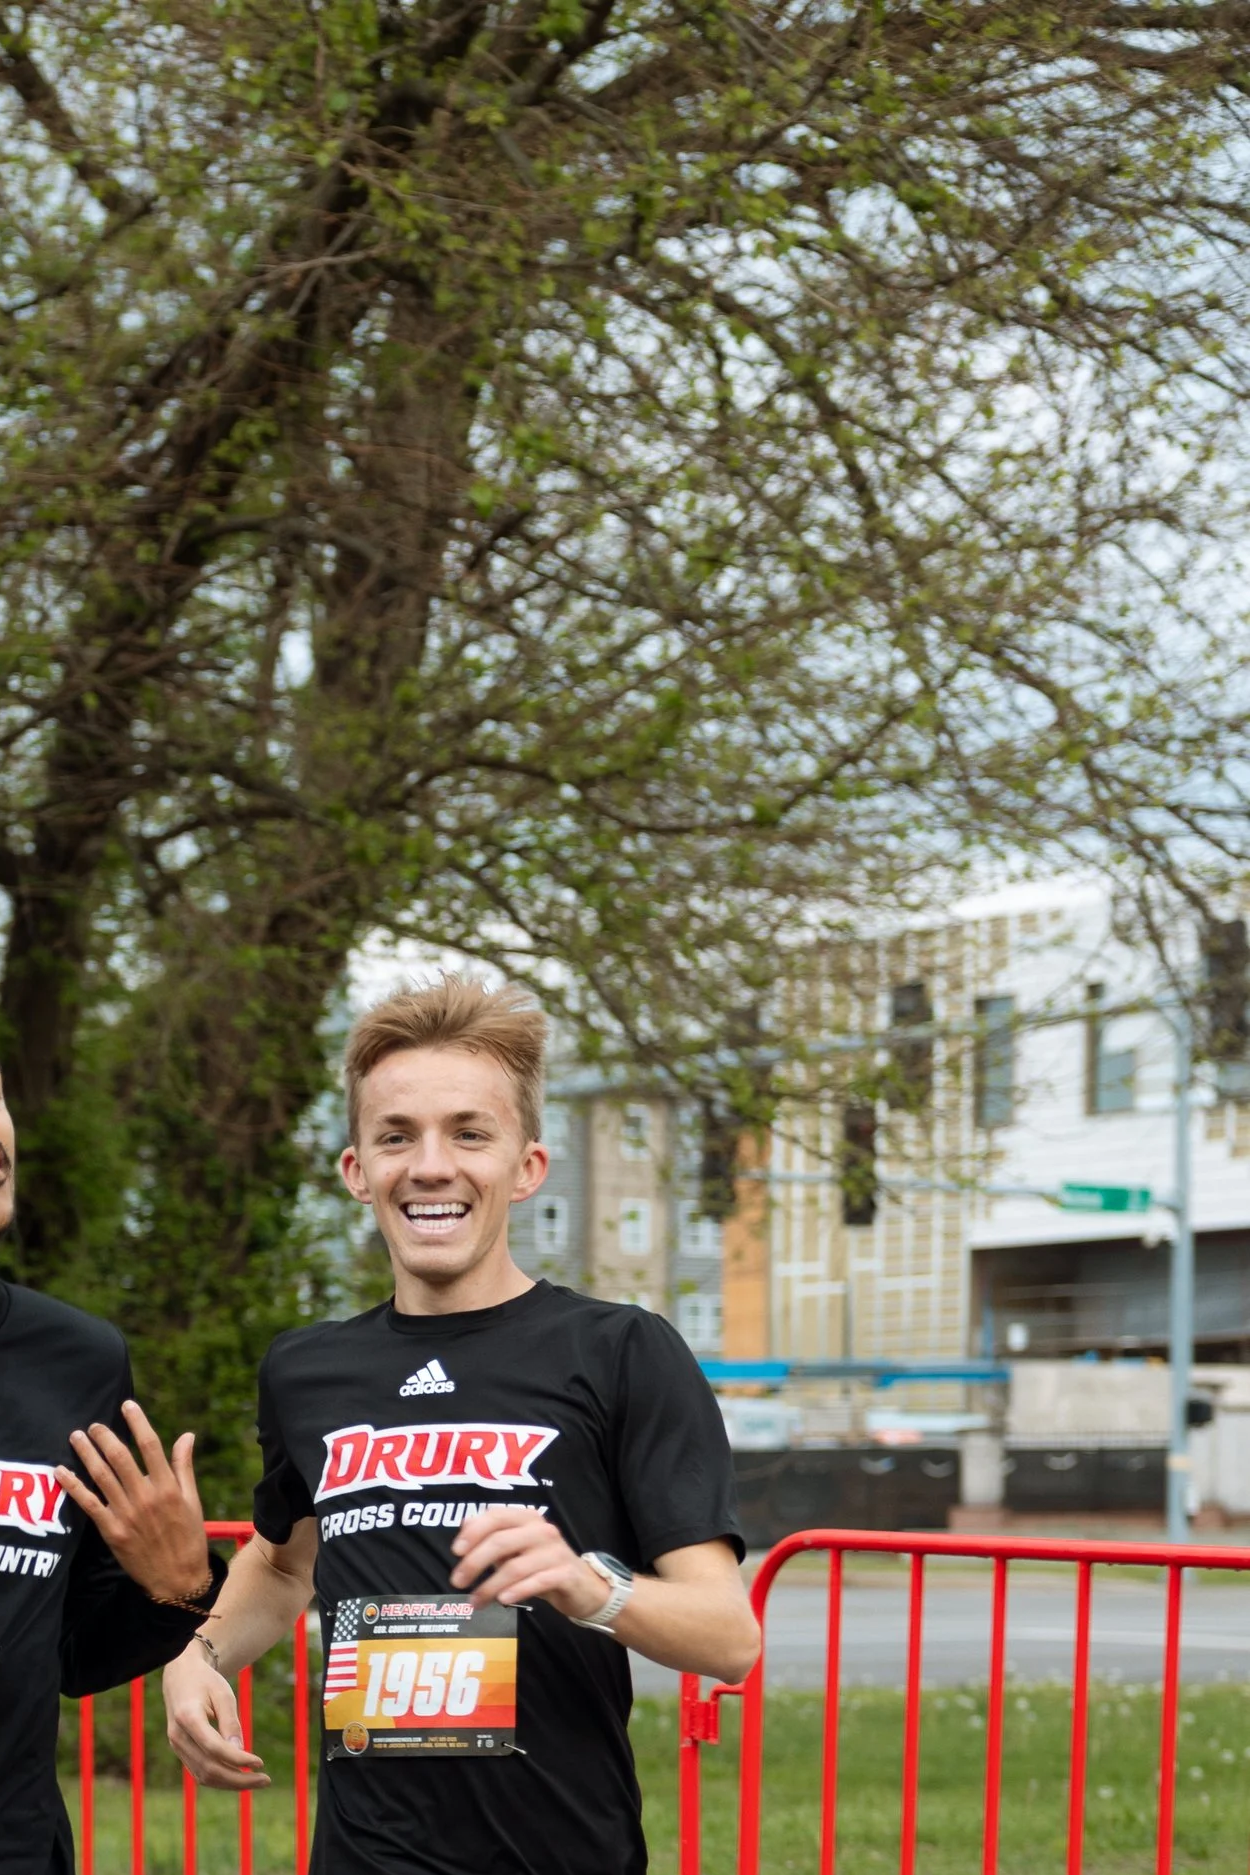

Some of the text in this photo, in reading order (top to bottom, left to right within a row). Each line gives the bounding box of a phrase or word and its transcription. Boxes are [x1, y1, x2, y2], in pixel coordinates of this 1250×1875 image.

[400, 1380, 455, 1397] adidas
[315, 1424, 554, 1502] DRURY
[321, 1504, 395, 1543] CROSS
[380, 1603, 474, 1617] HEARTLAND
[363, 1650, 486, 1717] 1956
